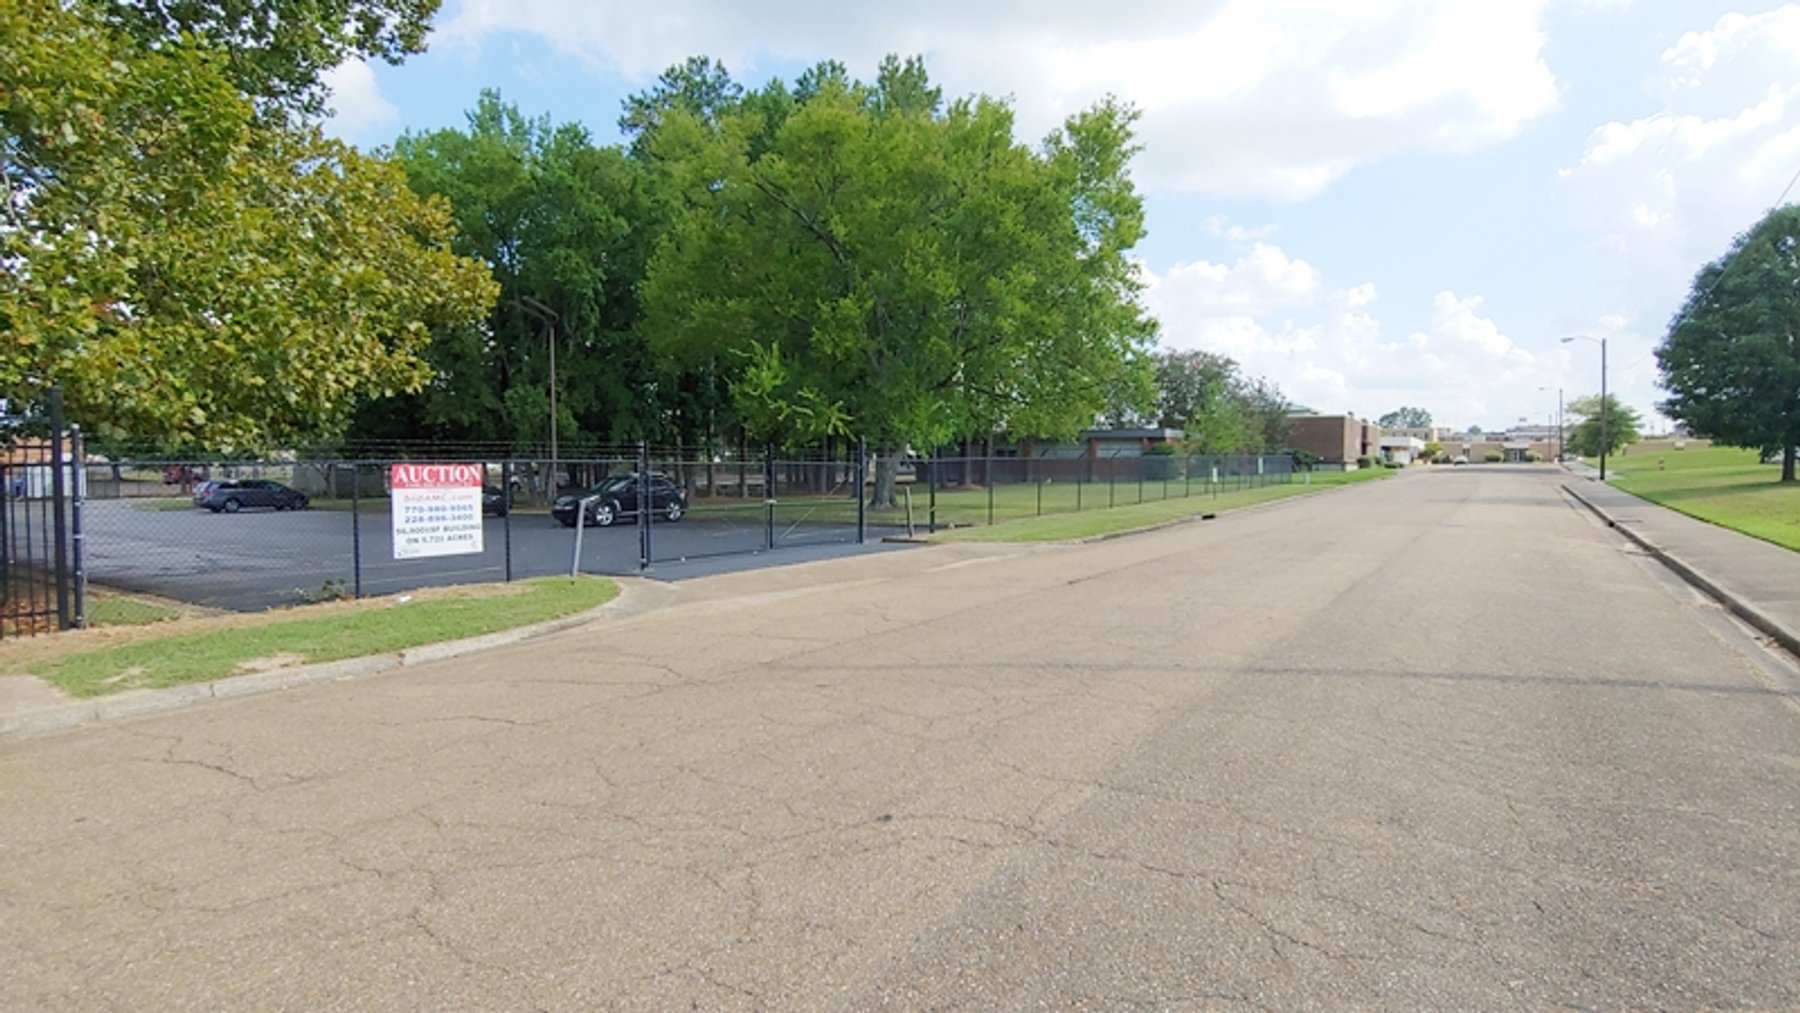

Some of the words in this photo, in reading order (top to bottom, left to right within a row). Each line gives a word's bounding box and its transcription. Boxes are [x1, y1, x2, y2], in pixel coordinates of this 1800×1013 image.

[393, 465, 482, 483] AUCTION
[442, 524, 481, 533] BUILDING
[446, 534, 474, 542] ACRES
